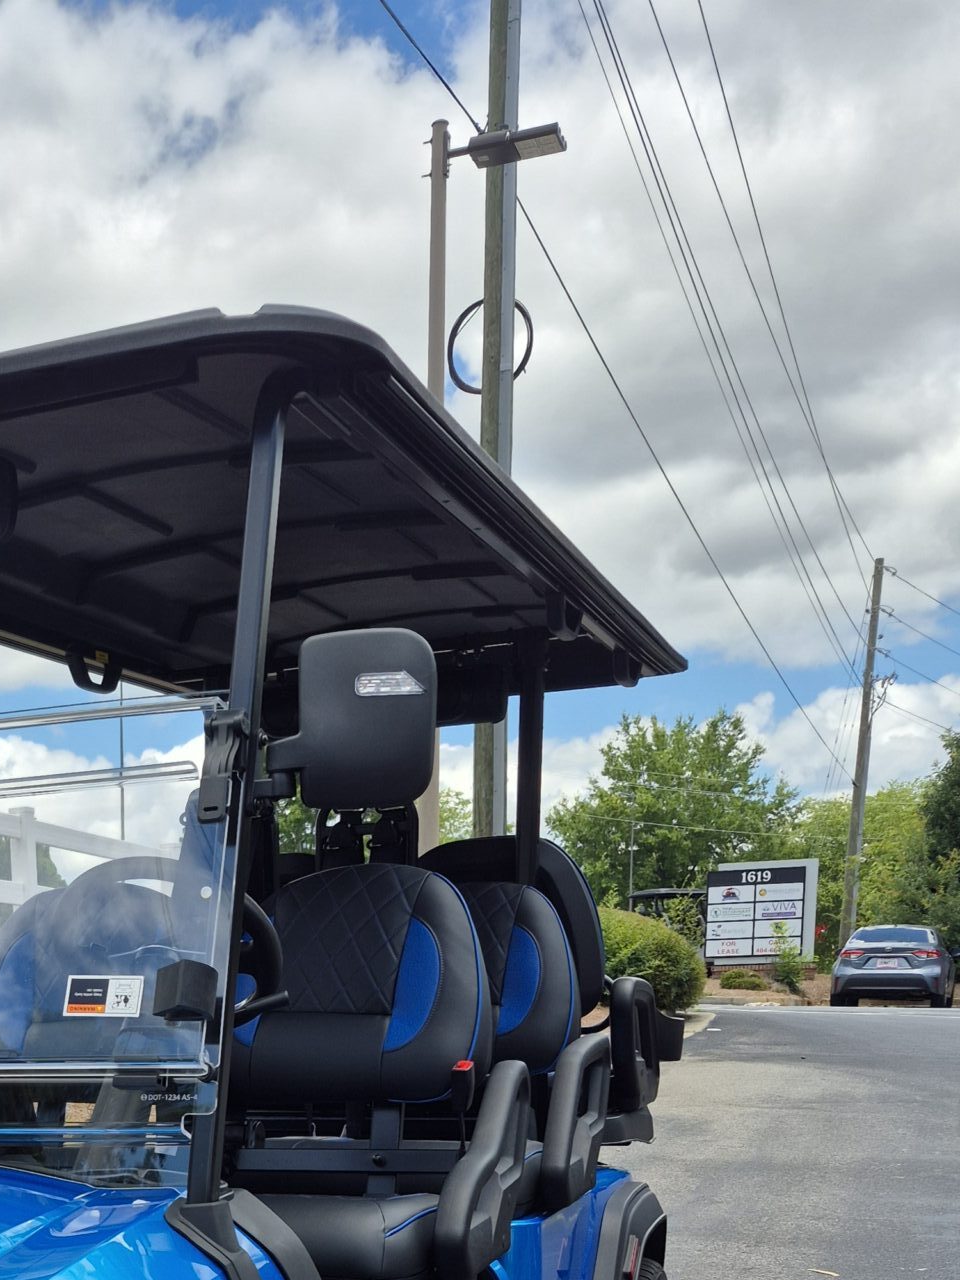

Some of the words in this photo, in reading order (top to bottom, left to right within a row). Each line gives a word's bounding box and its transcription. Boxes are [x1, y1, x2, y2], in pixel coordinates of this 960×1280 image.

[741, 870, 771, 883] 1619
[772, 902, 797, 911] VIVA
[148, 1093, 181, 1101] DOT-1234
